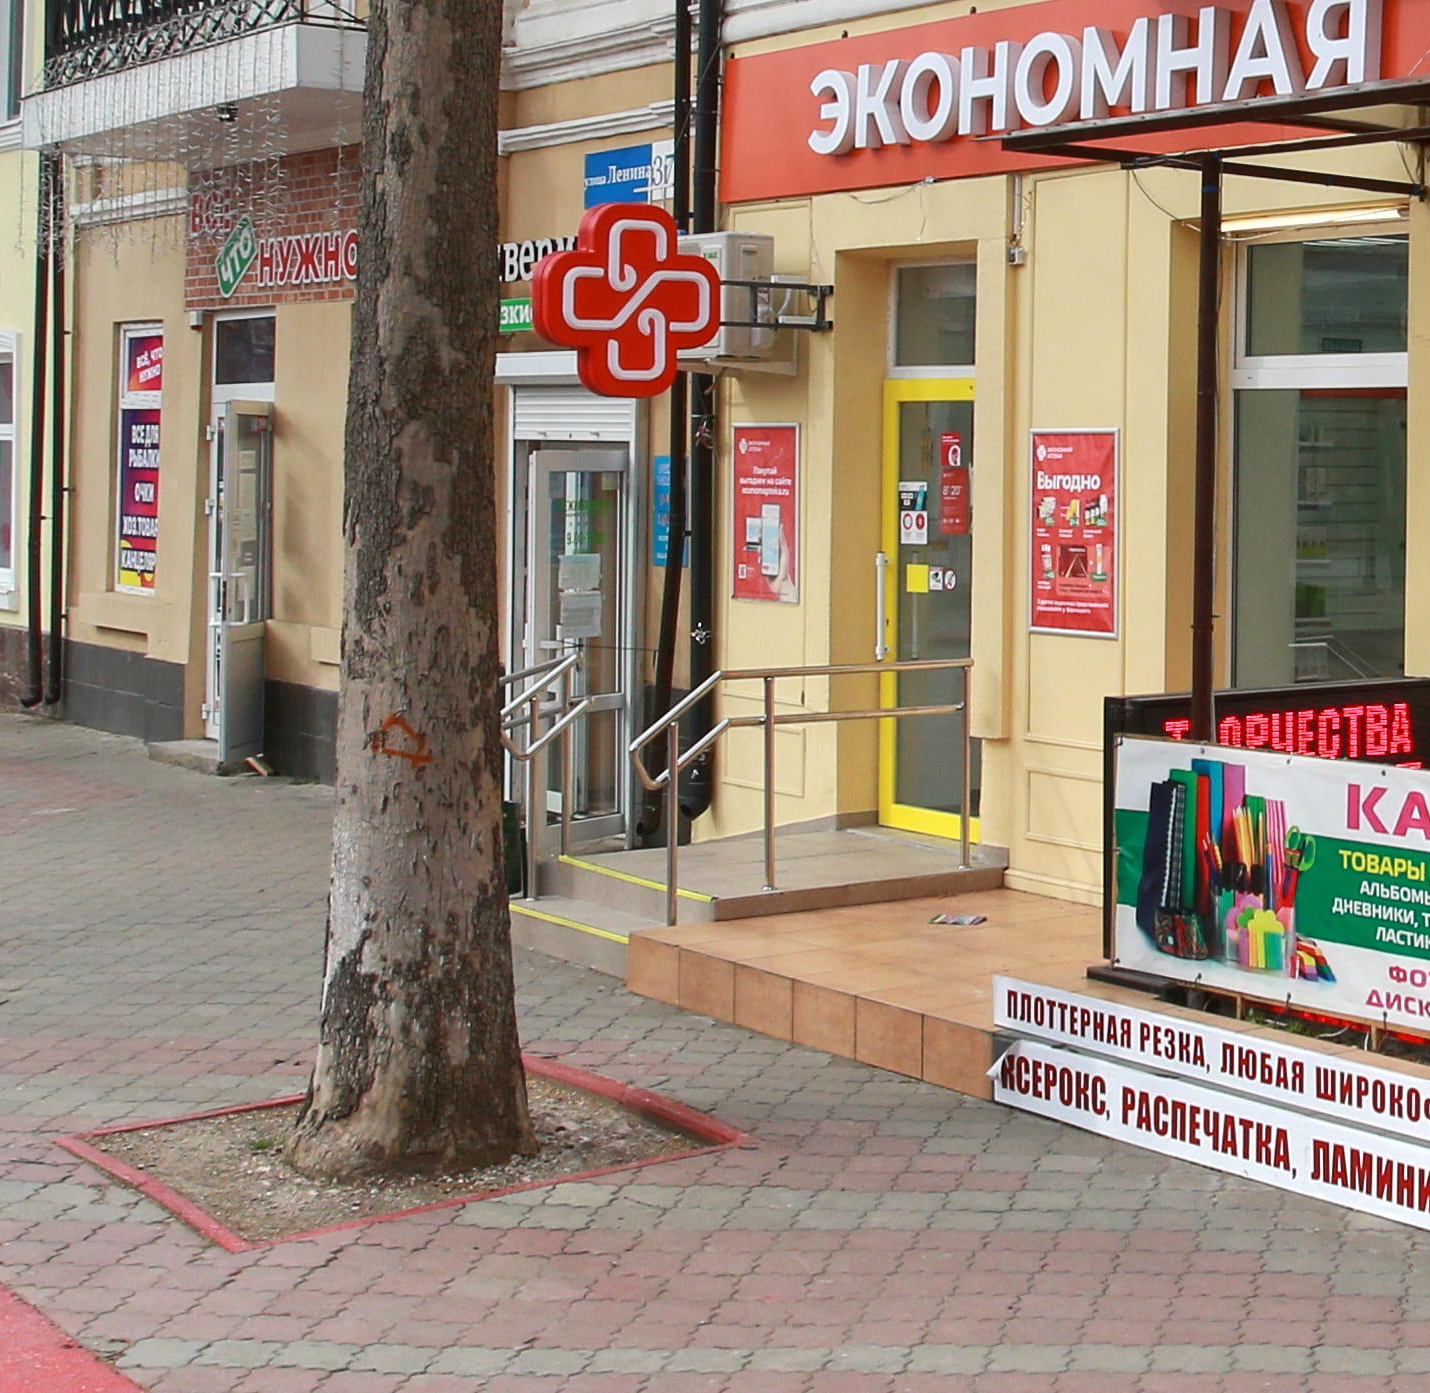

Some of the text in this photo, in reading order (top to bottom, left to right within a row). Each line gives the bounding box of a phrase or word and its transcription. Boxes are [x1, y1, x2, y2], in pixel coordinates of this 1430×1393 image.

[607, 165, 652, 184] Ленина
[257, 229, 359, 287] НУЖНО
[1037, 470, 1101, 493] Выгодно
[1165, 703, 1413, 758] ОРЧЕСТВА
[1339, 849, 1425, 881] ТОВАРЫ
[1332, 897, 1419, 927] ДНЕВНИКИ,
[1006, 988, 1132, 1048] ПЛОТТЕРНАЯ
[1139, 1020, 1212, 1074] РЕЗКА,
[1220, 1042, 1305, 1095] ЛЮБАЯ
[1000, 1052, 1111, 1121] КСЕРОКС,
[1121, 1085, 1298, 1181] РАСПЕЧАТКА,
